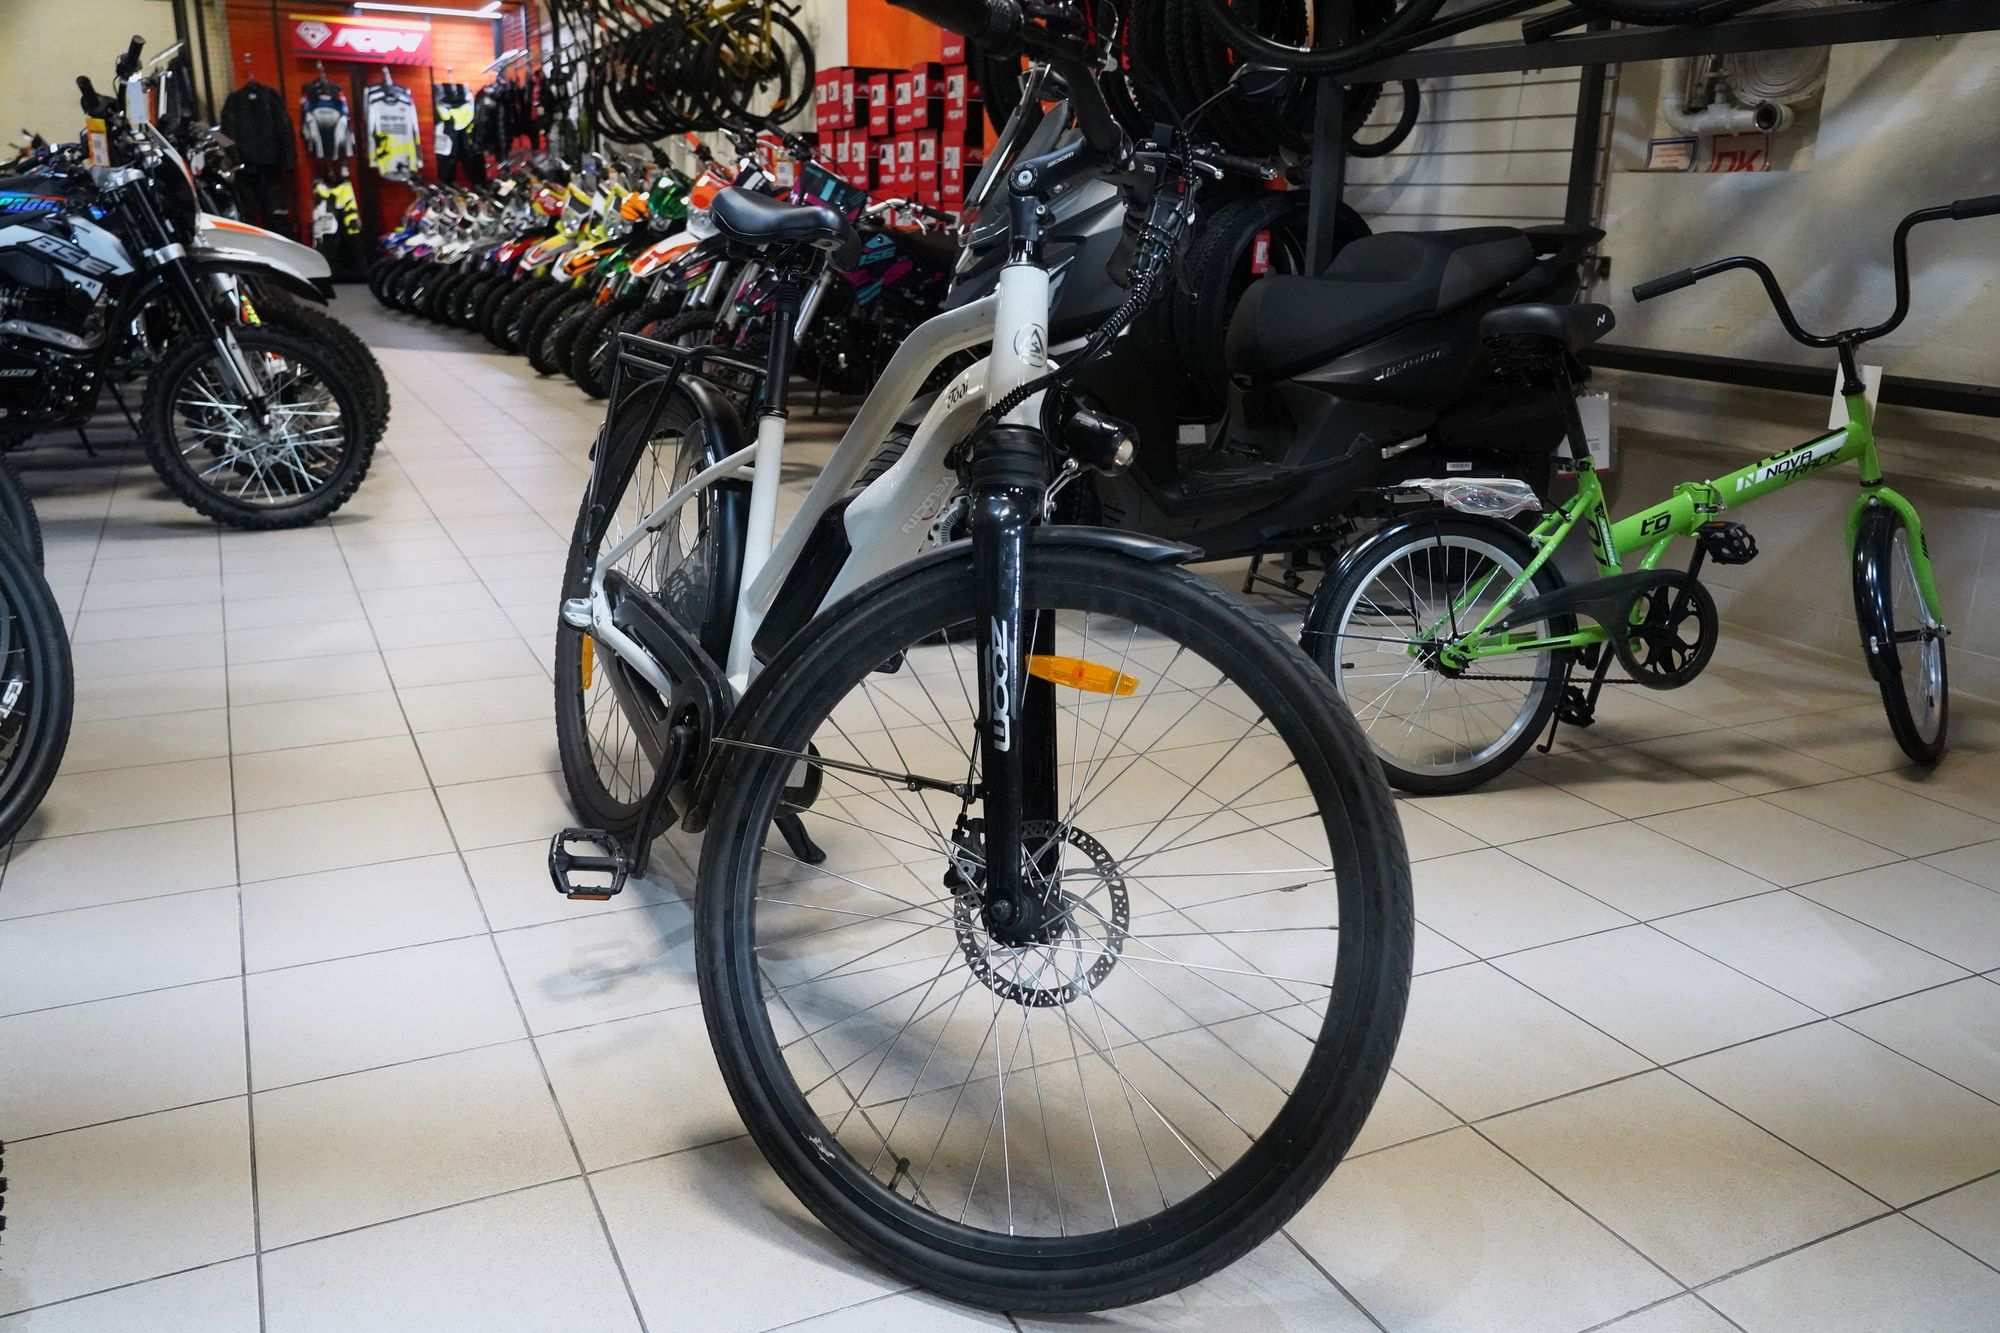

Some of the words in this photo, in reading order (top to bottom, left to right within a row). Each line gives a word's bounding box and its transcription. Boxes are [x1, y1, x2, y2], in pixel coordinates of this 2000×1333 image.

[26, 237, 116, 276] BSE
[1765, 450, 1813, 480] NOVA
[1782, 447, 1841, 481] TRACK
